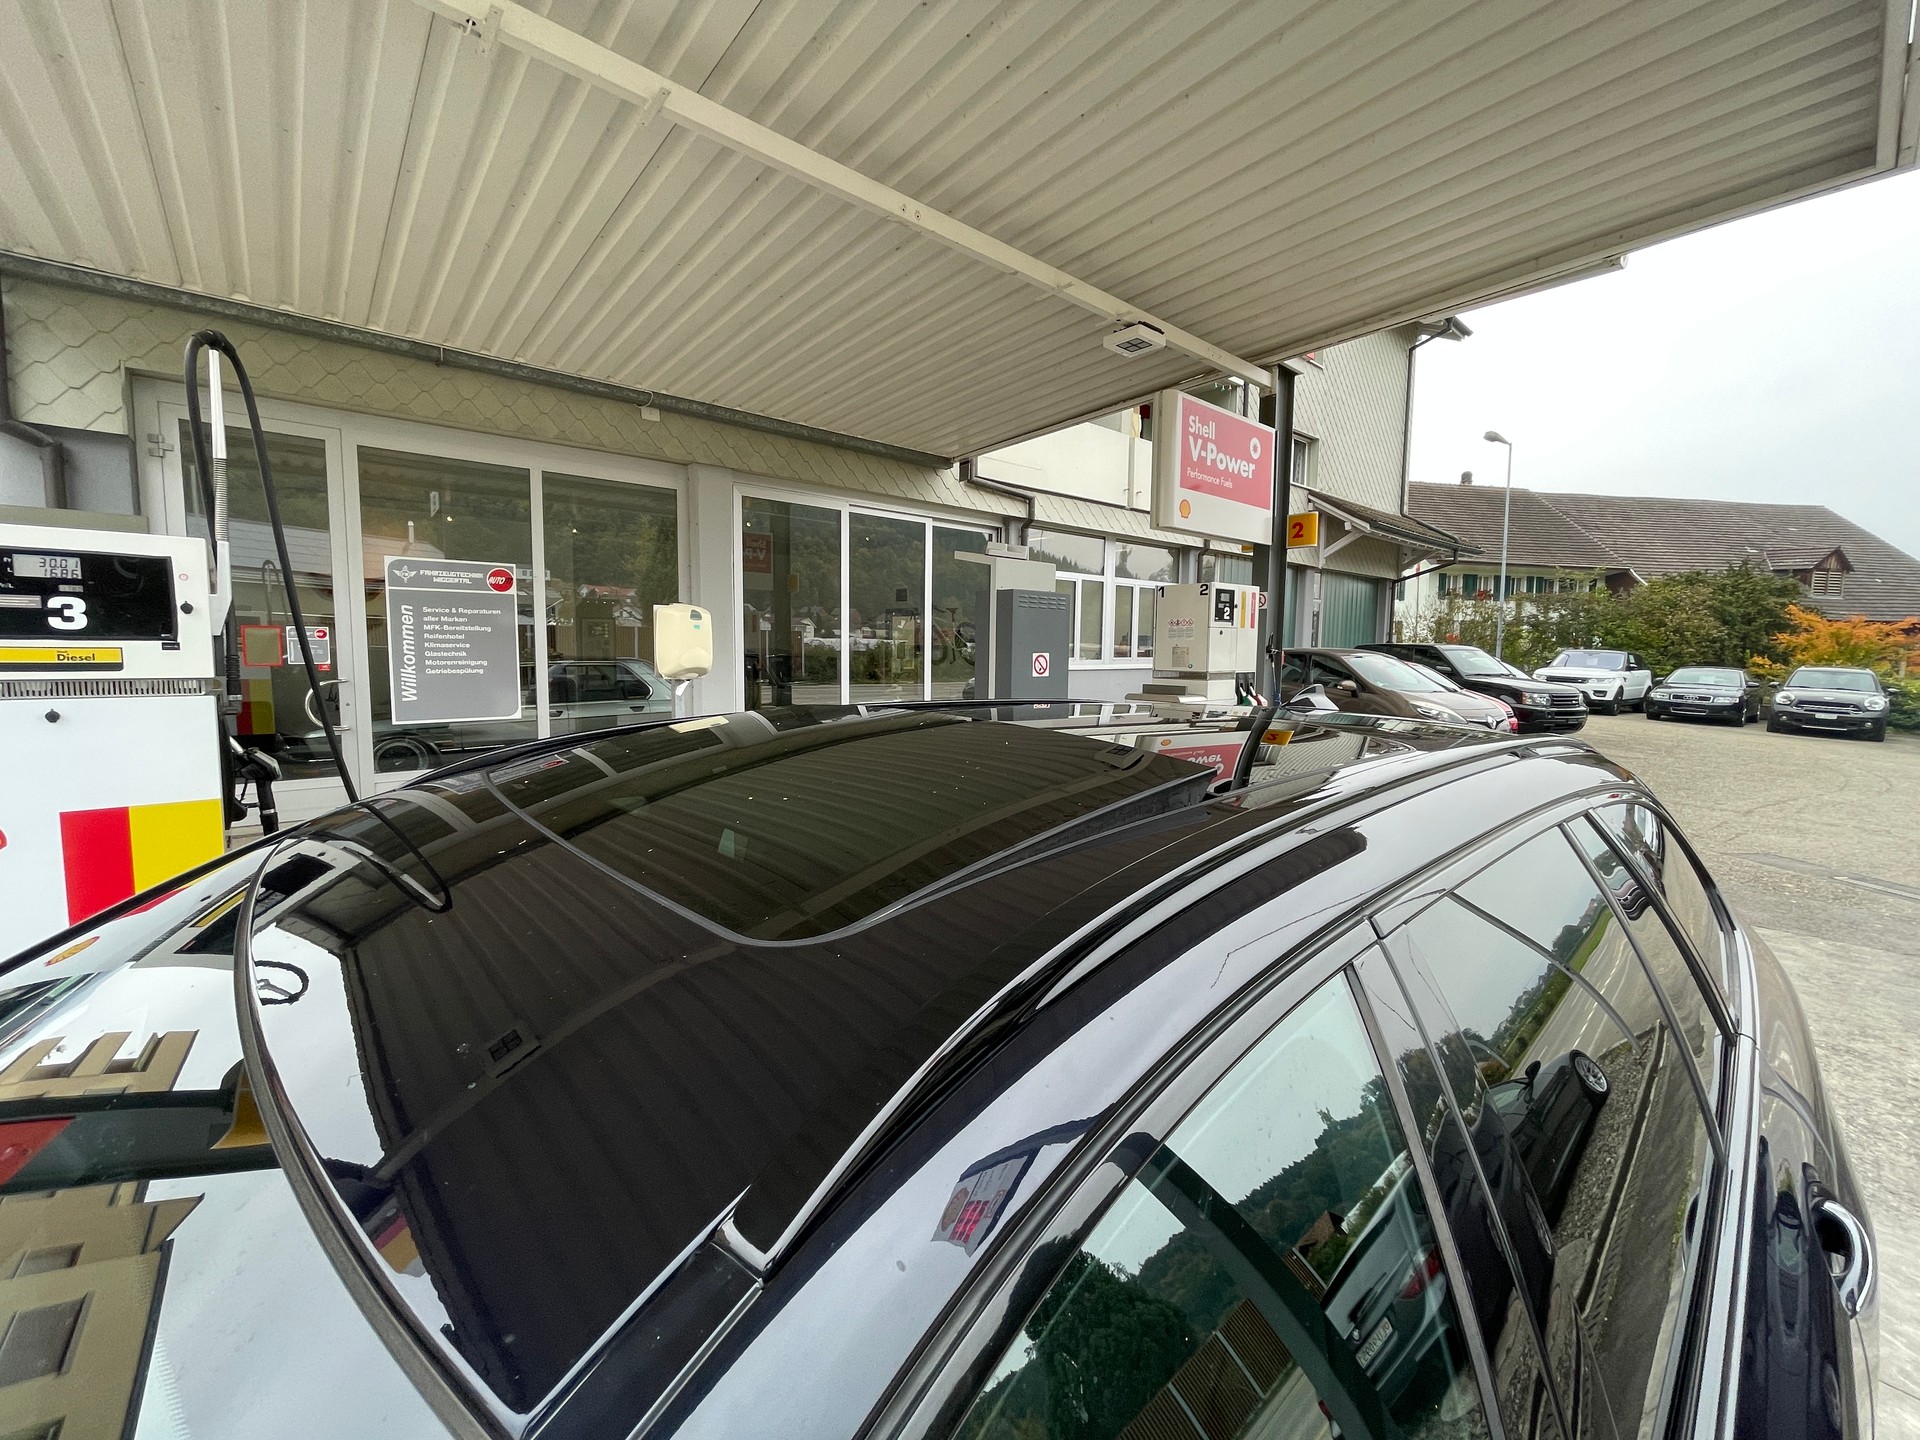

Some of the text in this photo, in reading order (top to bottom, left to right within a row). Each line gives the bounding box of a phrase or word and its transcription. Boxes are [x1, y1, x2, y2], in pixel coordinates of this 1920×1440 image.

[1188, 415, 1216, 440] Shell
[1188, 436, 1256, 479] V-Power
[1187, 467, 1233, 489] Performance Fuels
[1291, 522, 1304, 539] 2
[1158, 586, 1165, 598] 1
[1200, 584, 1209, 596] 2
[47, 596, 88, 630] 3
[1223, 606, 1231, 620] 2
[57, 653, 96, 661] Diesel
[400, 604, 417, 702] Willkommen
